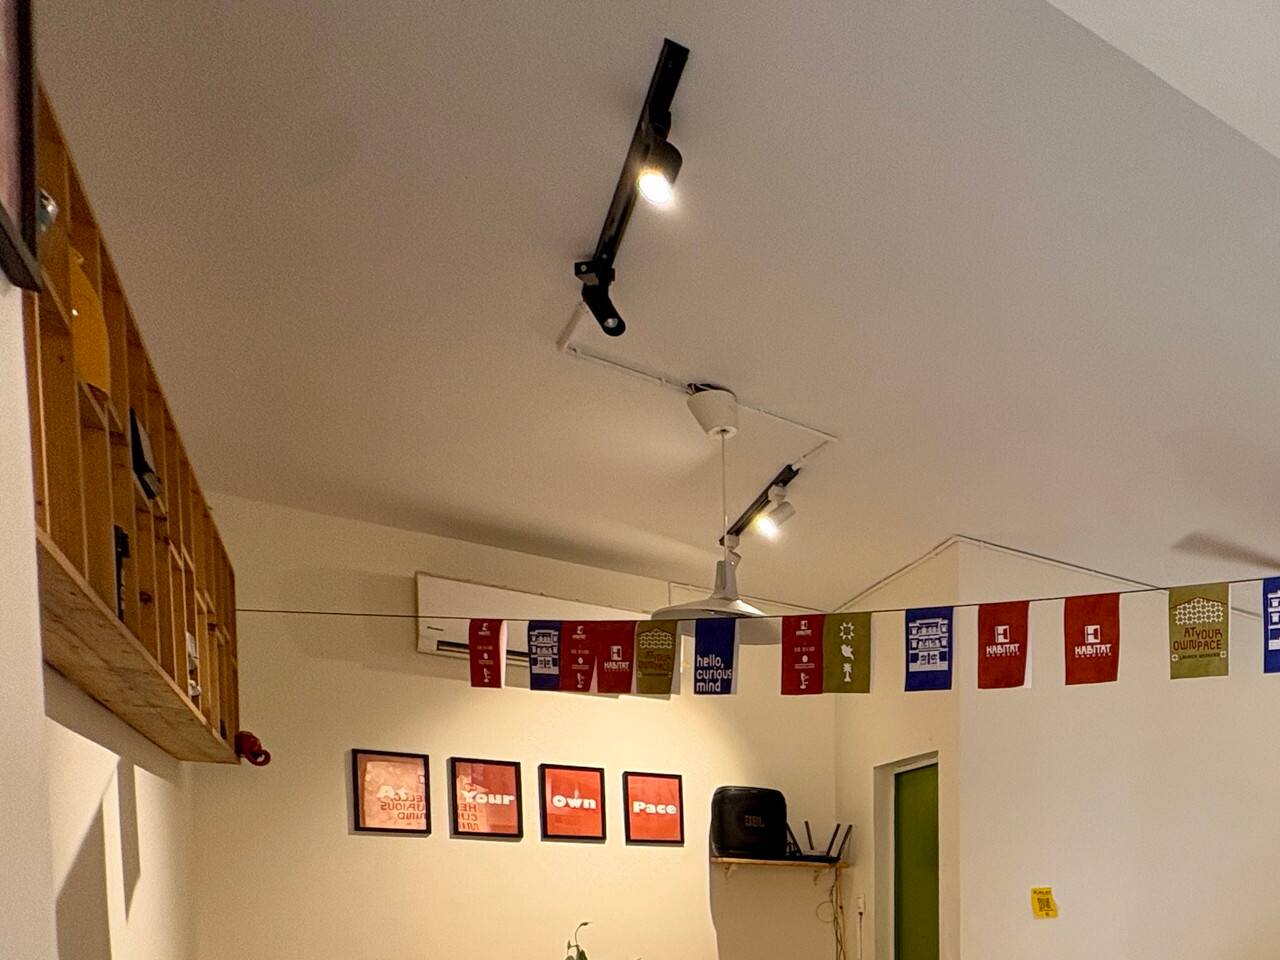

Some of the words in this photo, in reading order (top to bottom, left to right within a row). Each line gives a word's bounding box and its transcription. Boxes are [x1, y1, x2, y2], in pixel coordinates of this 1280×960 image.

[986, 643, 1020, 654] HABITAT
[1075, 644, 1112, 656] HABITAT
[696, 654, 724, 669] hello,
[696, 666, 733, 680] curious
[696, 679, 721, 692] mind
[460, 790, 516, 805] Your
[552, 794, 597, 809] Own
[632, 801, 677, 815] Pace
